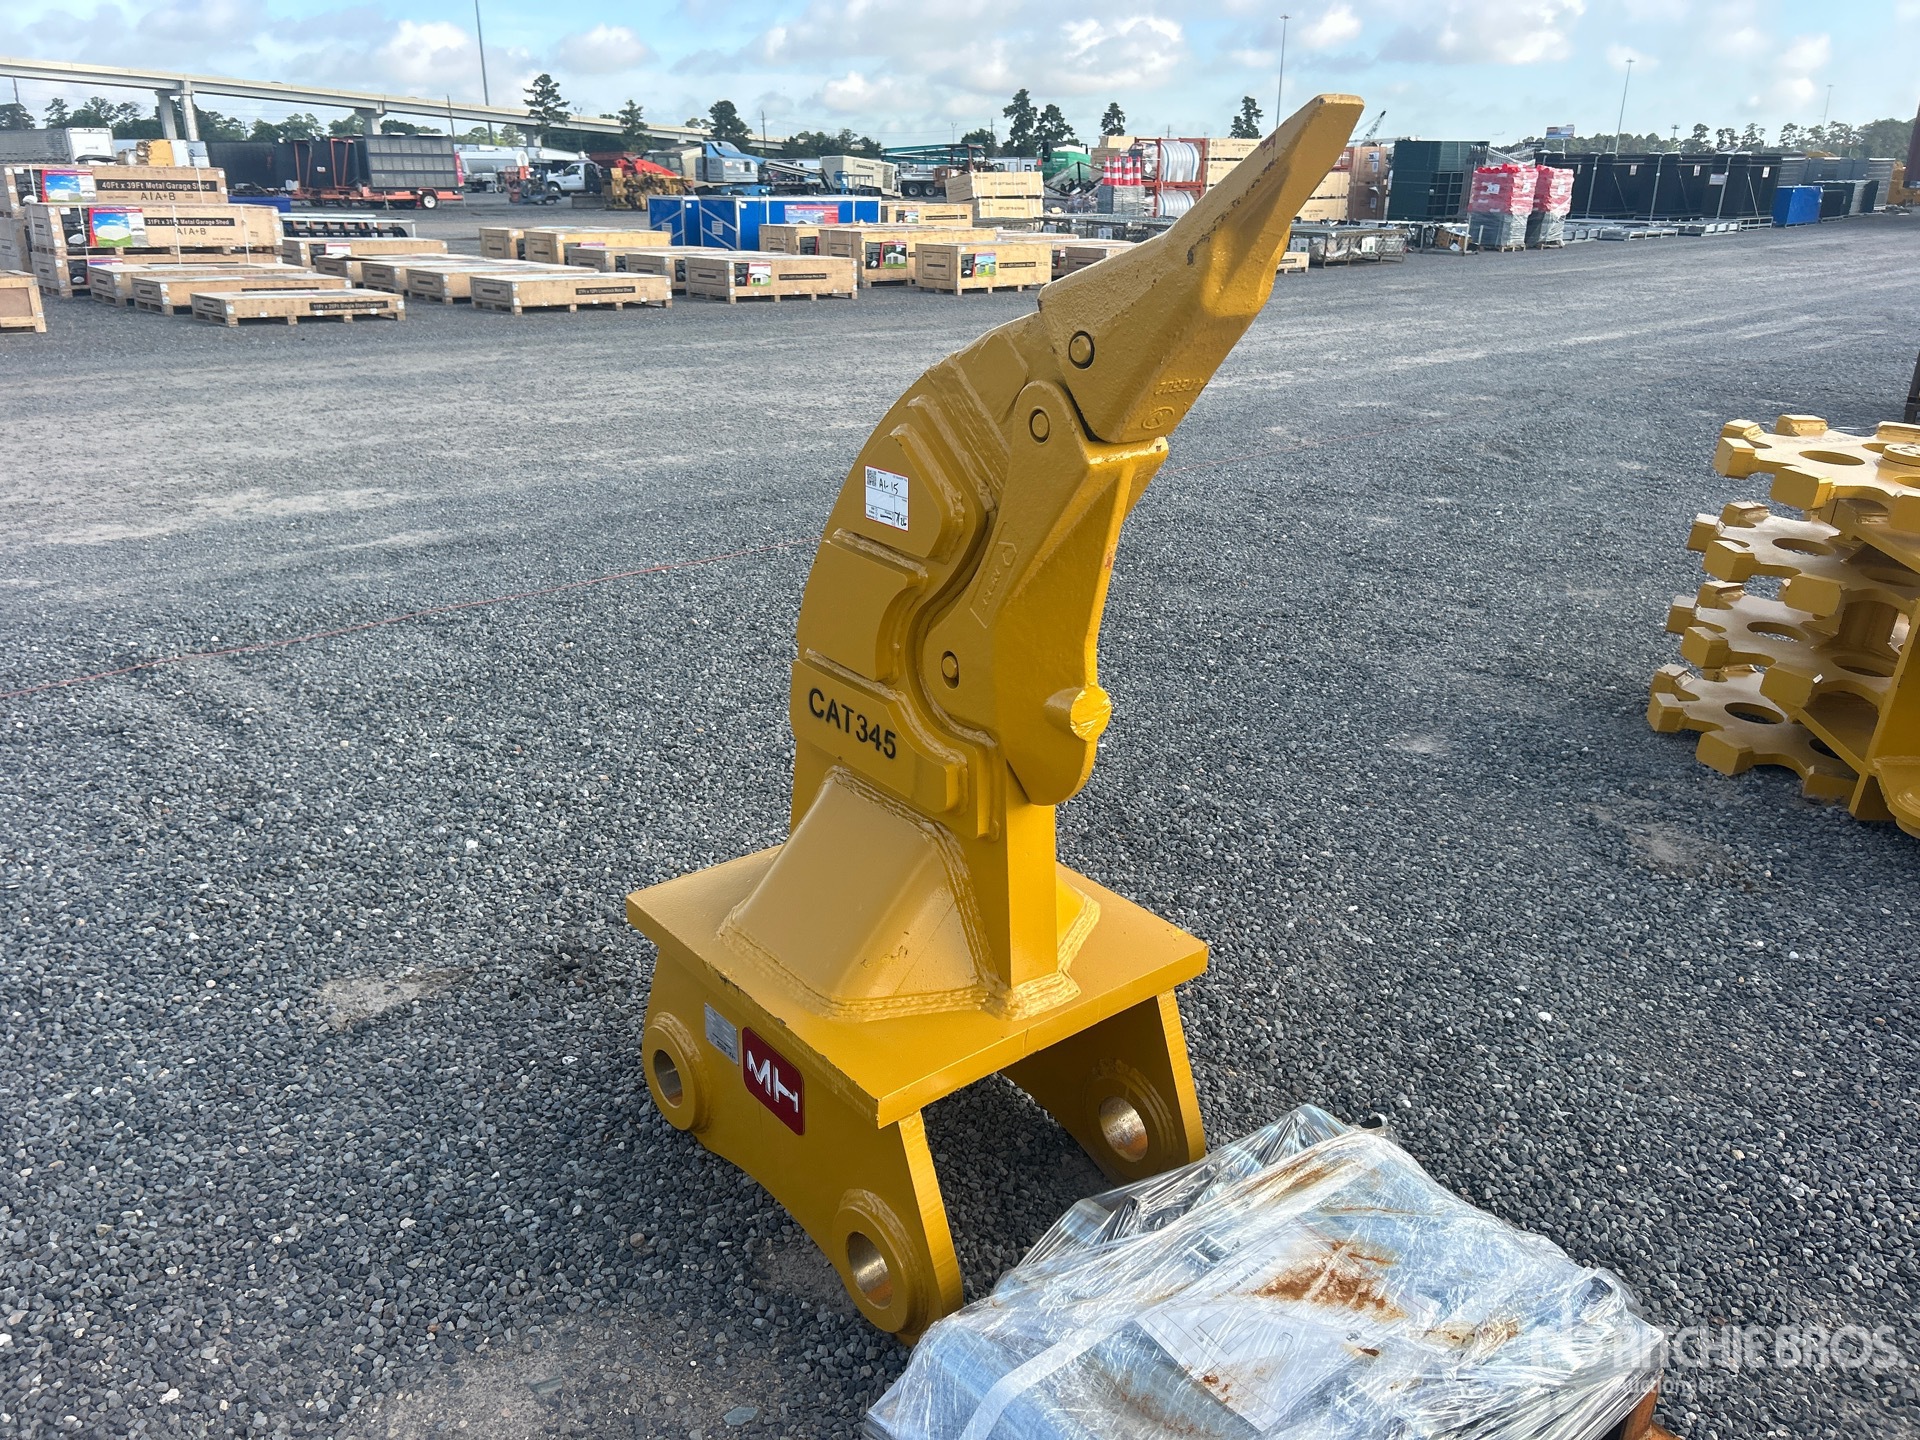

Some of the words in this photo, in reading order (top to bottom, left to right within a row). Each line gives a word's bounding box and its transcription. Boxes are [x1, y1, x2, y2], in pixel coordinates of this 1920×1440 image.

[101, 181, 119, 189] 40Ft
[146, 182, 165, 190] Metal
[165, 182, 191, 191] Garage
[808, 687, 897, 759] CAT345
